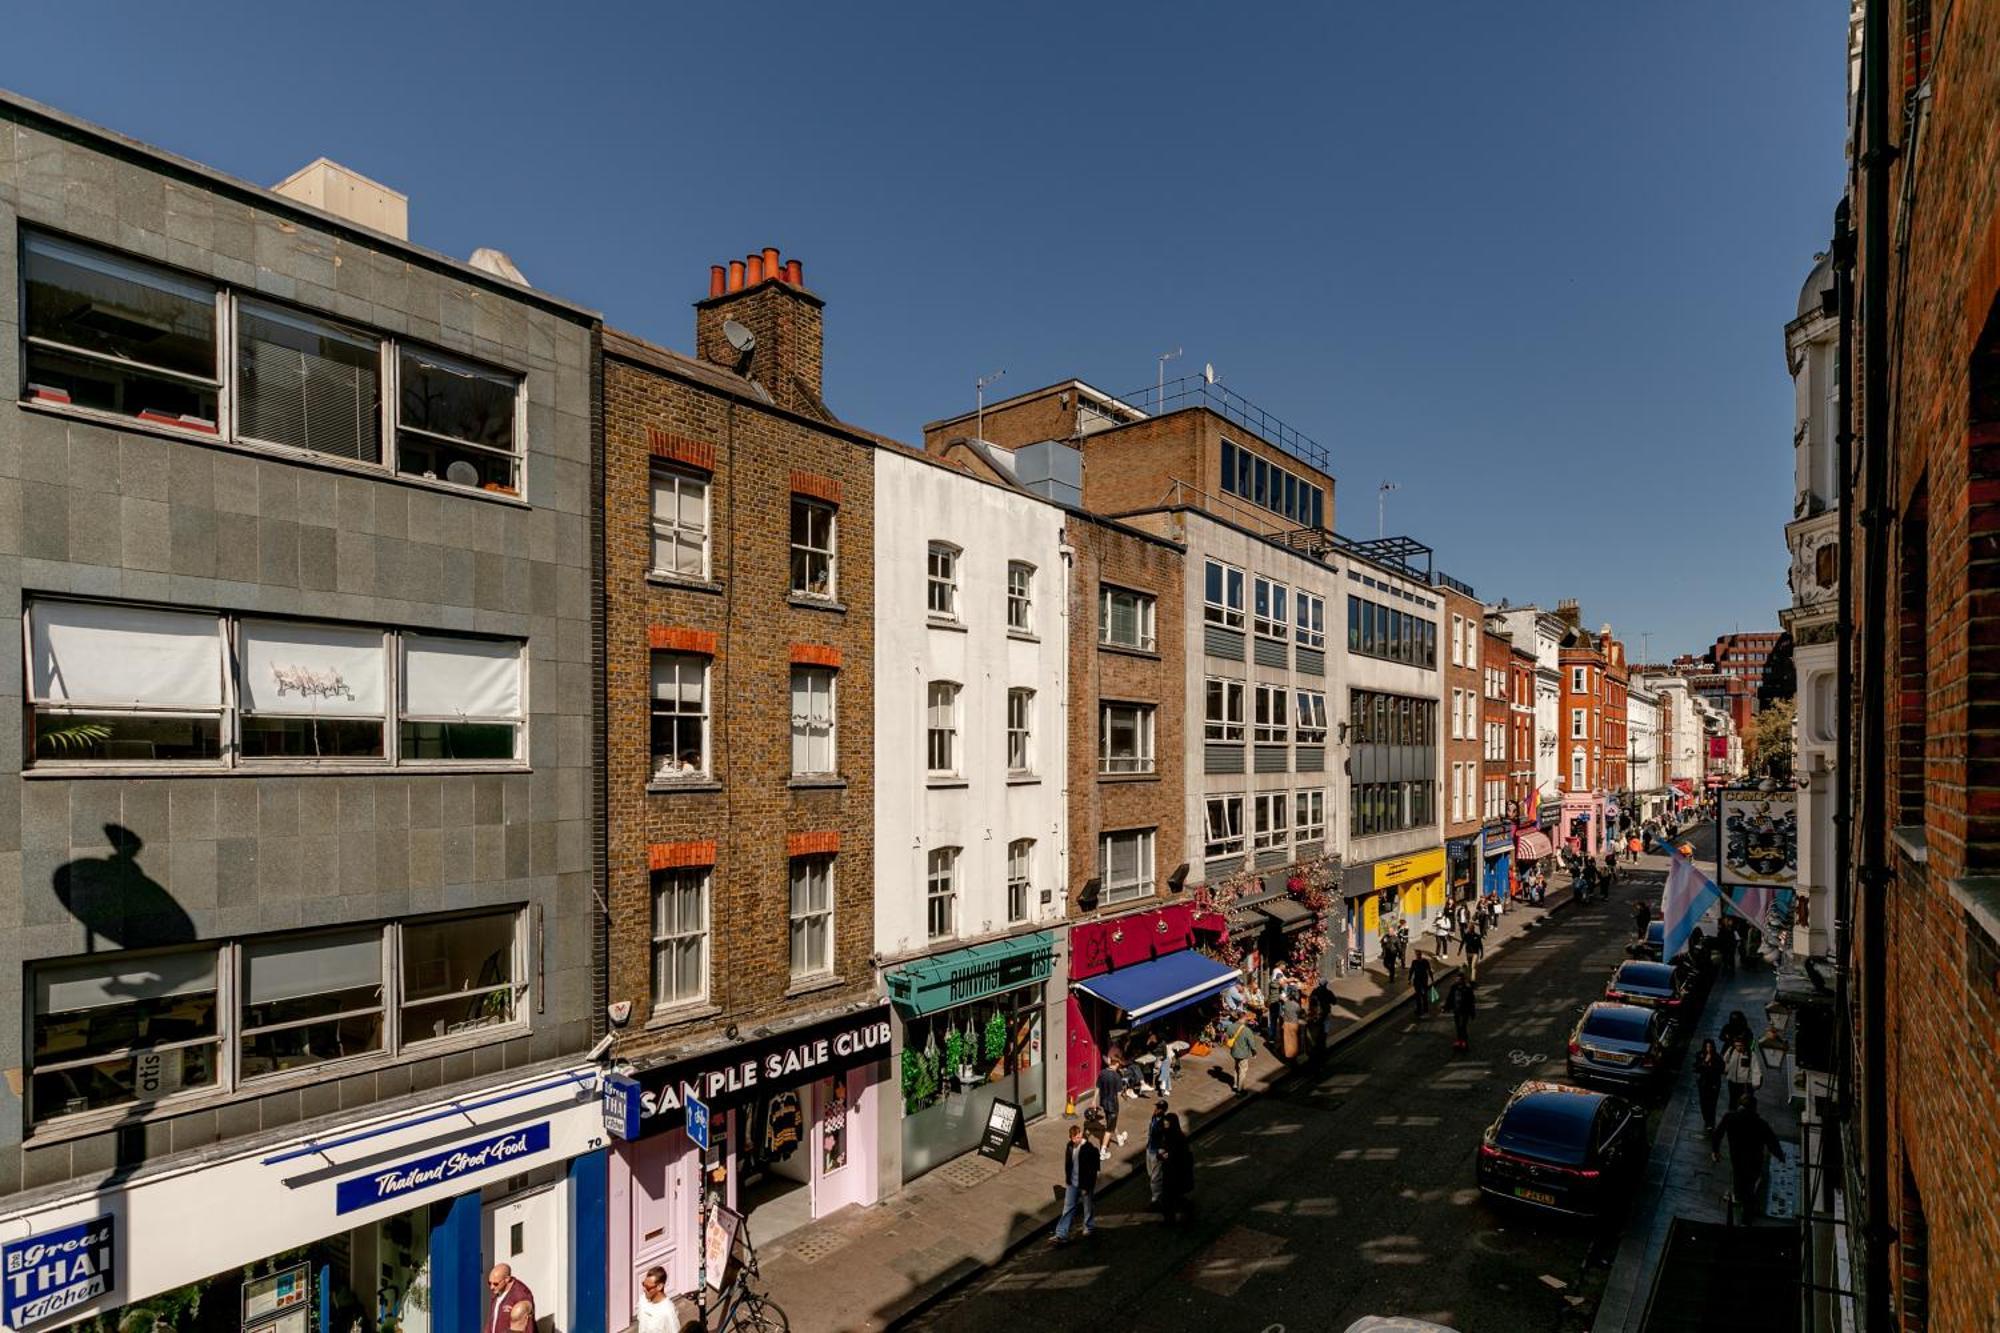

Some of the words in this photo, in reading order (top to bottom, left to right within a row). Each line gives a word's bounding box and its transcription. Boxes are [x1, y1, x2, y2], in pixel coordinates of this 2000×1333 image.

[950, 959, 1000, 1001] RUNWAY
[765, 1040, 830, 1079] SALE
[833, 1022, 892, 1057] CLUB
[588, 1138, 602, 1149] 70
[375, 1161, 445, 1197] Thailand
[446, 1146, 492, 1177] Street
[490, 1134, 528, 1159] Food
[24, 1227, 110, 1268] Great
[7, 1247, 110, 1299] THAI
[20, 1282, 101, 1325] Kitchen
